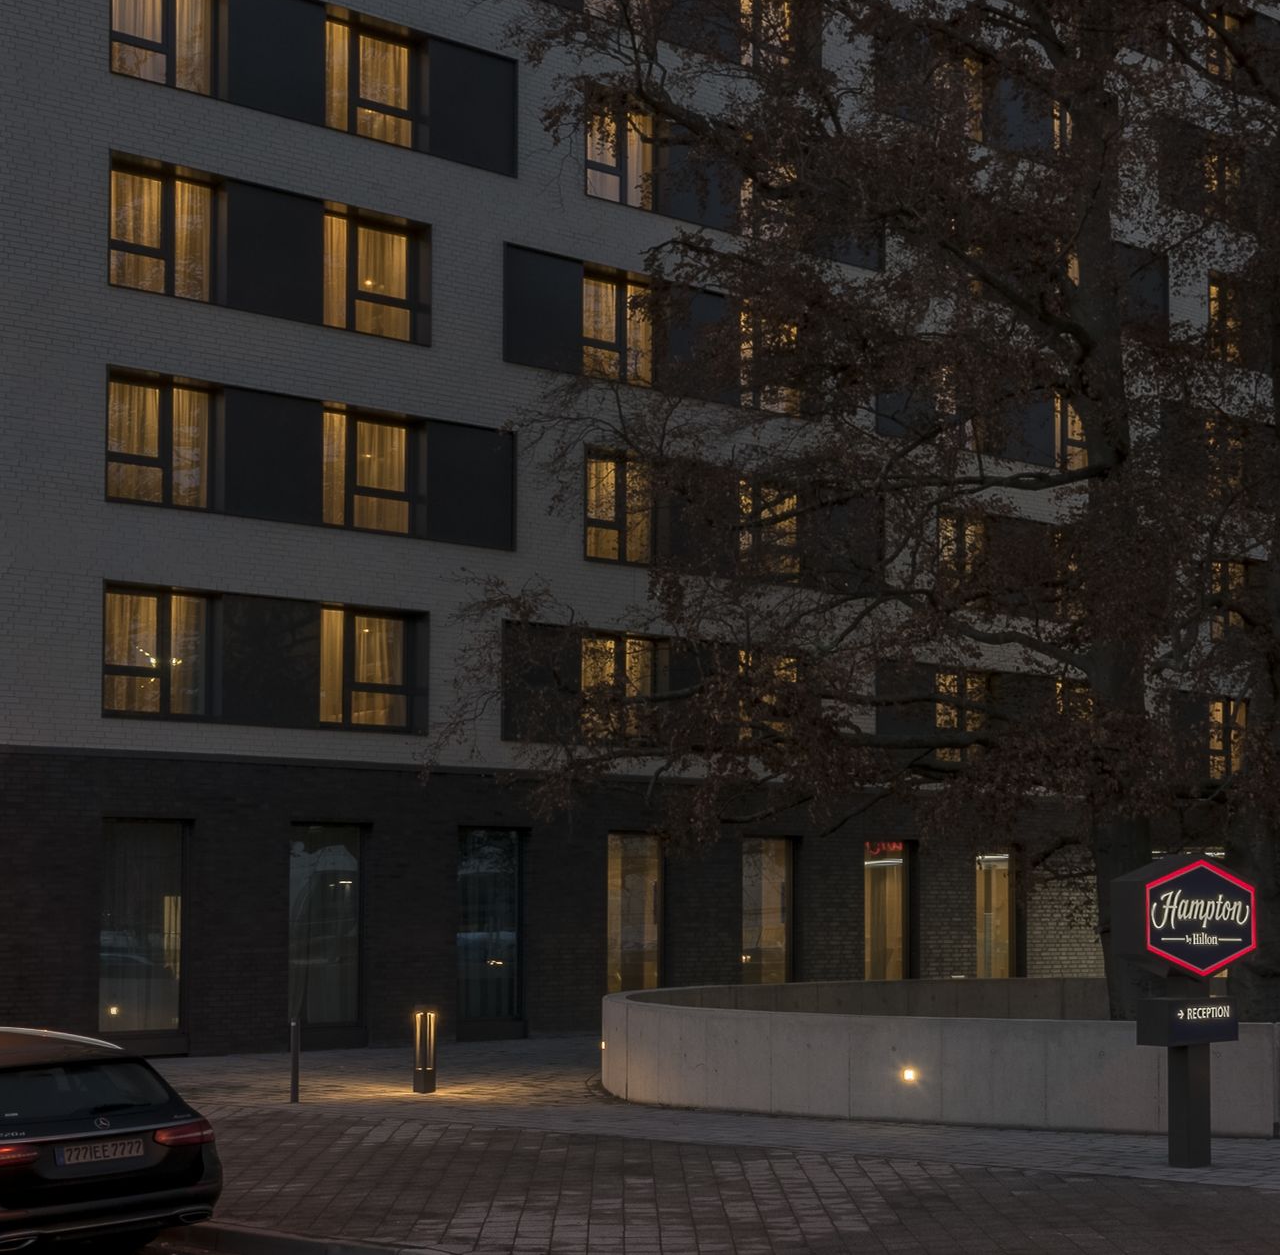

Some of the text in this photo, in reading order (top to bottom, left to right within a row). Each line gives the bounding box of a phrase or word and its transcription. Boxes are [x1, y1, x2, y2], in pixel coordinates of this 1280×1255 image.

[1151, 889, 1250, 930] Hampton
[1192, 932, 1219, 946] Hilton
[1187, 1005, 1230, 1020] RECEPTION
